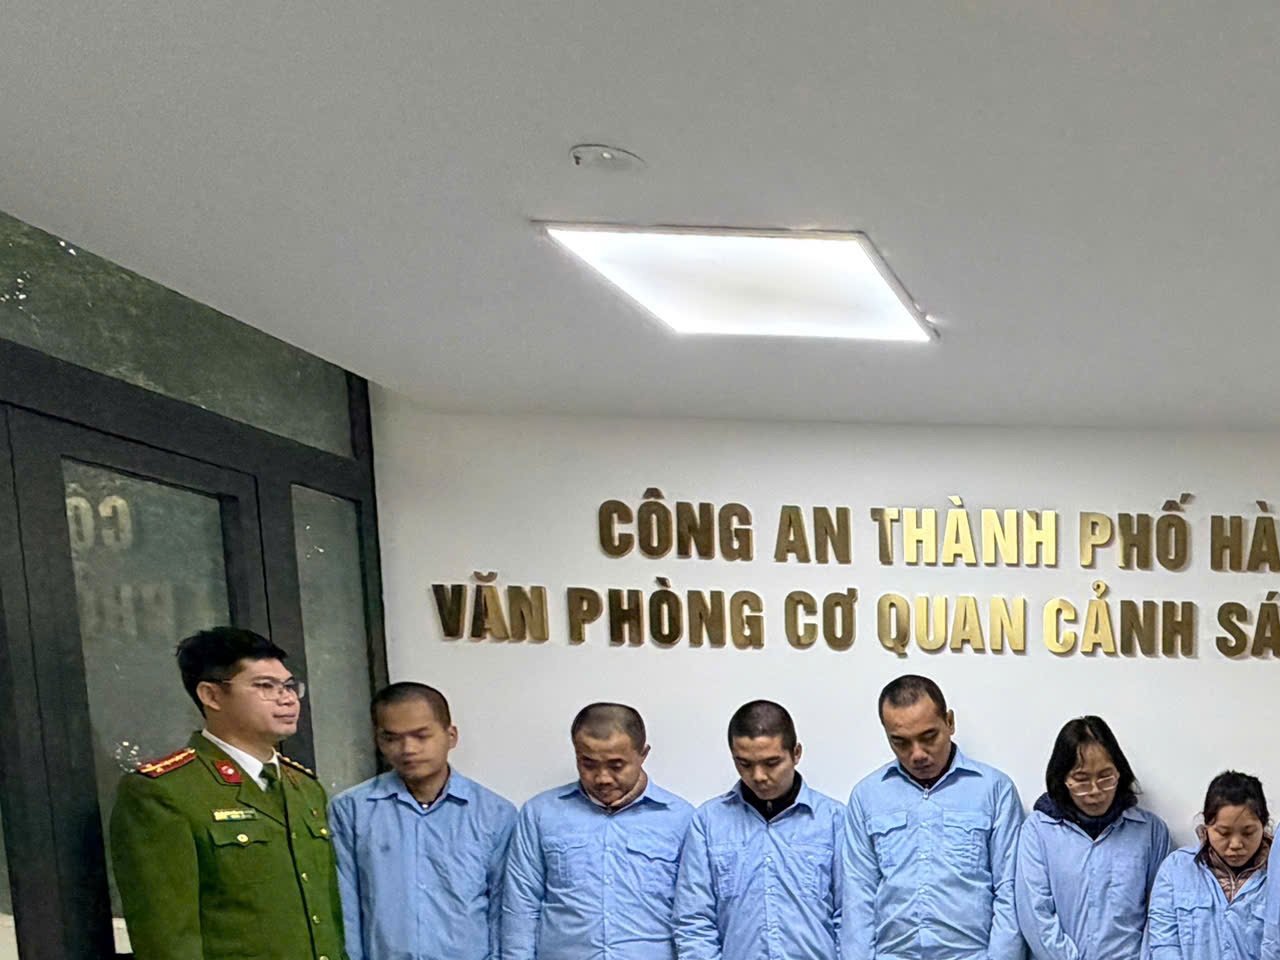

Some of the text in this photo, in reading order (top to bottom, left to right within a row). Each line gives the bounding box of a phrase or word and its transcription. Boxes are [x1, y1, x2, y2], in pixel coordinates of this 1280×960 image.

[599, 487, 754, 562] CÔNG
[774, 504, 853, 565] AN
[870, 496, 1058, 567] THÀNH
[1079, 493, 1195, 573] PHỐ
[431, 571, 549, 641] VĂN
[567, 576, 764, 650] PHÒNG
[785, 587, 858, 652] CƠ
[883, 593, 1026, 658] QUAN
[1043, 580, 1198, 658] CẢNH
